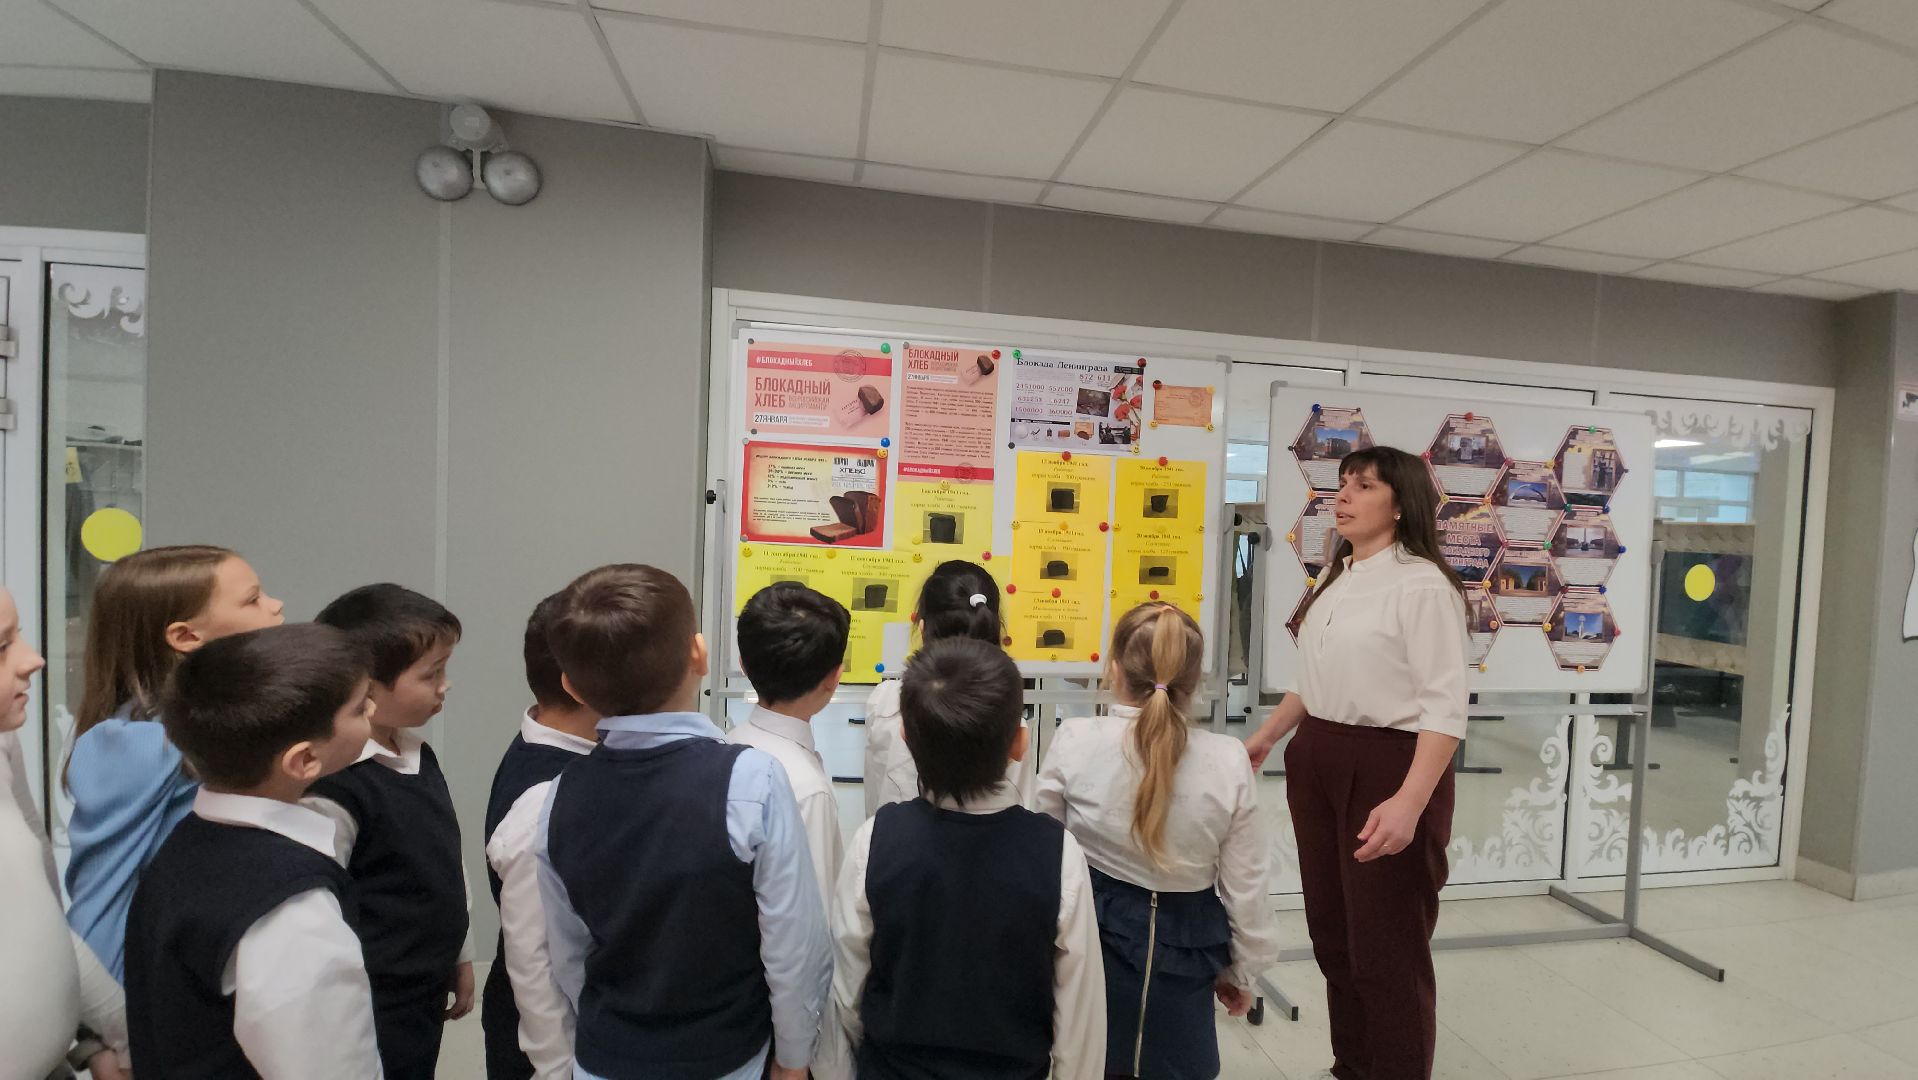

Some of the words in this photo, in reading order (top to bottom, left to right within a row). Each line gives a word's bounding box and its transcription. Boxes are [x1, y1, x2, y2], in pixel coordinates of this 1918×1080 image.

[908, 360, 929, 370] ХЛЕБ
[1017, 358, 1054, 368] Блокада
[1057, 361, 1109, 373] Ленинграда
[755, 377, 831, 395] БЛОКАДНЫЙ
[755, 393, 786, 408] ХЛЕБ
[1446, 533, 1482, 546] МЕСТА
